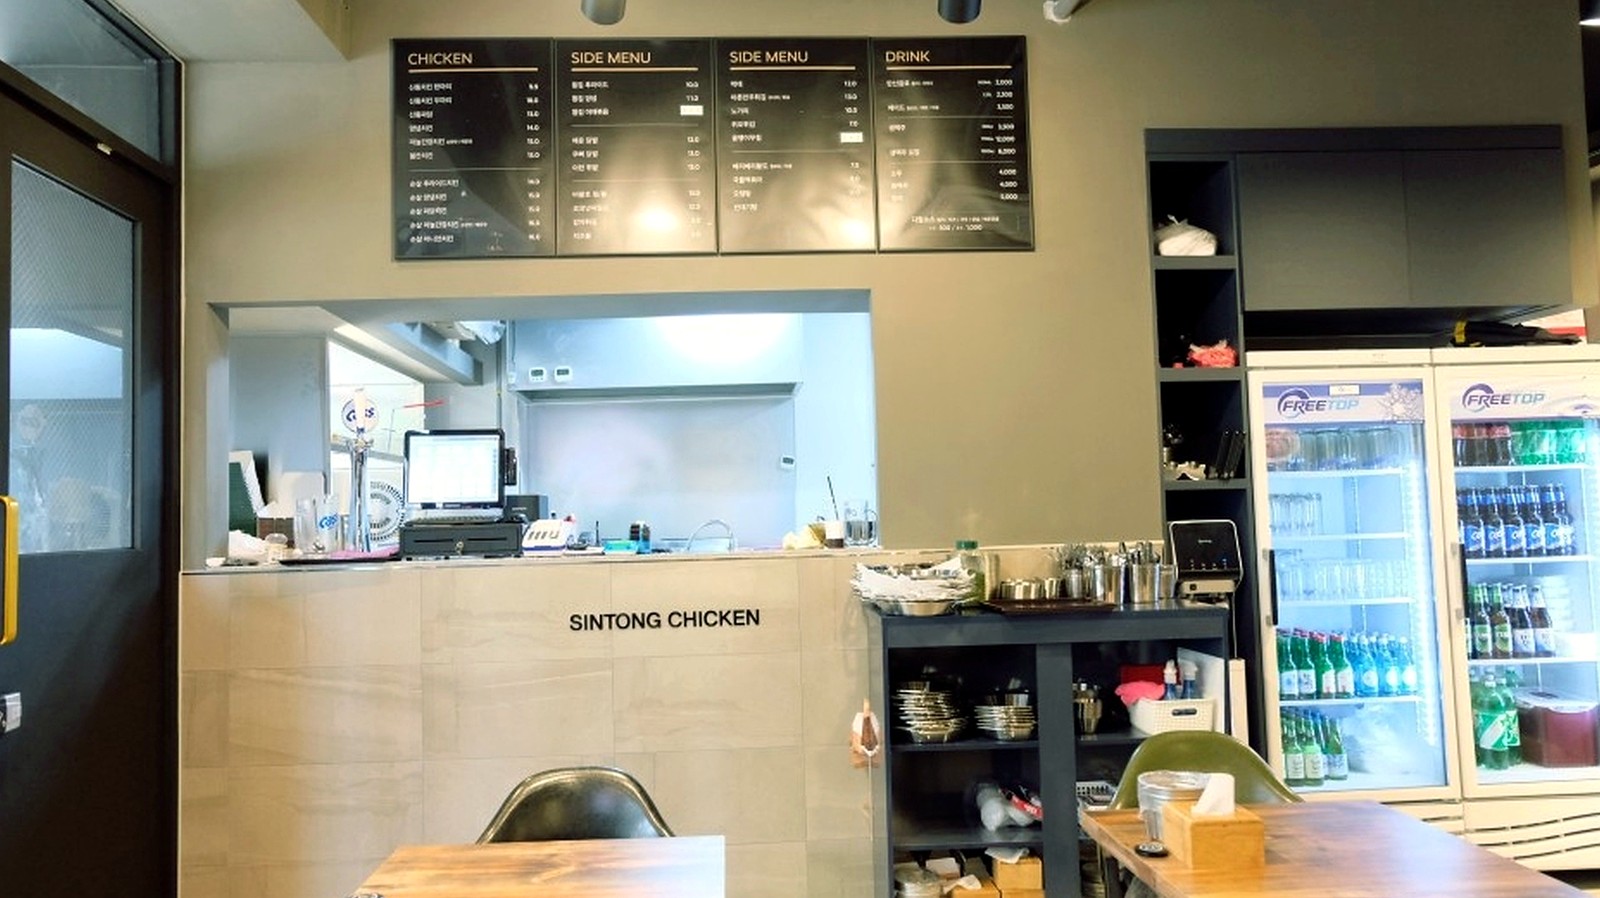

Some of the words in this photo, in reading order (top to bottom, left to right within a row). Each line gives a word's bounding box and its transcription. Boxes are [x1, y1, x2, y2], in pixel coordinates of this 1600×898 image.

[408, 53, 473, 65] CHICKEN
[571, 52, 603, 64] SIDE
[608, 52, 651, 64] MENU
[730, 52, 762, 63] SIDE
[766, 51, 808, 62] MENU
[886, 50, 930, 62] DRINK
[1282, 399, 1360, 414] FREETOP
[1467, 393, 1546, 408] FREETOP
[570, 612, 661, 631] SINTONG
[668, 609, 760, 628] CHICKEN
